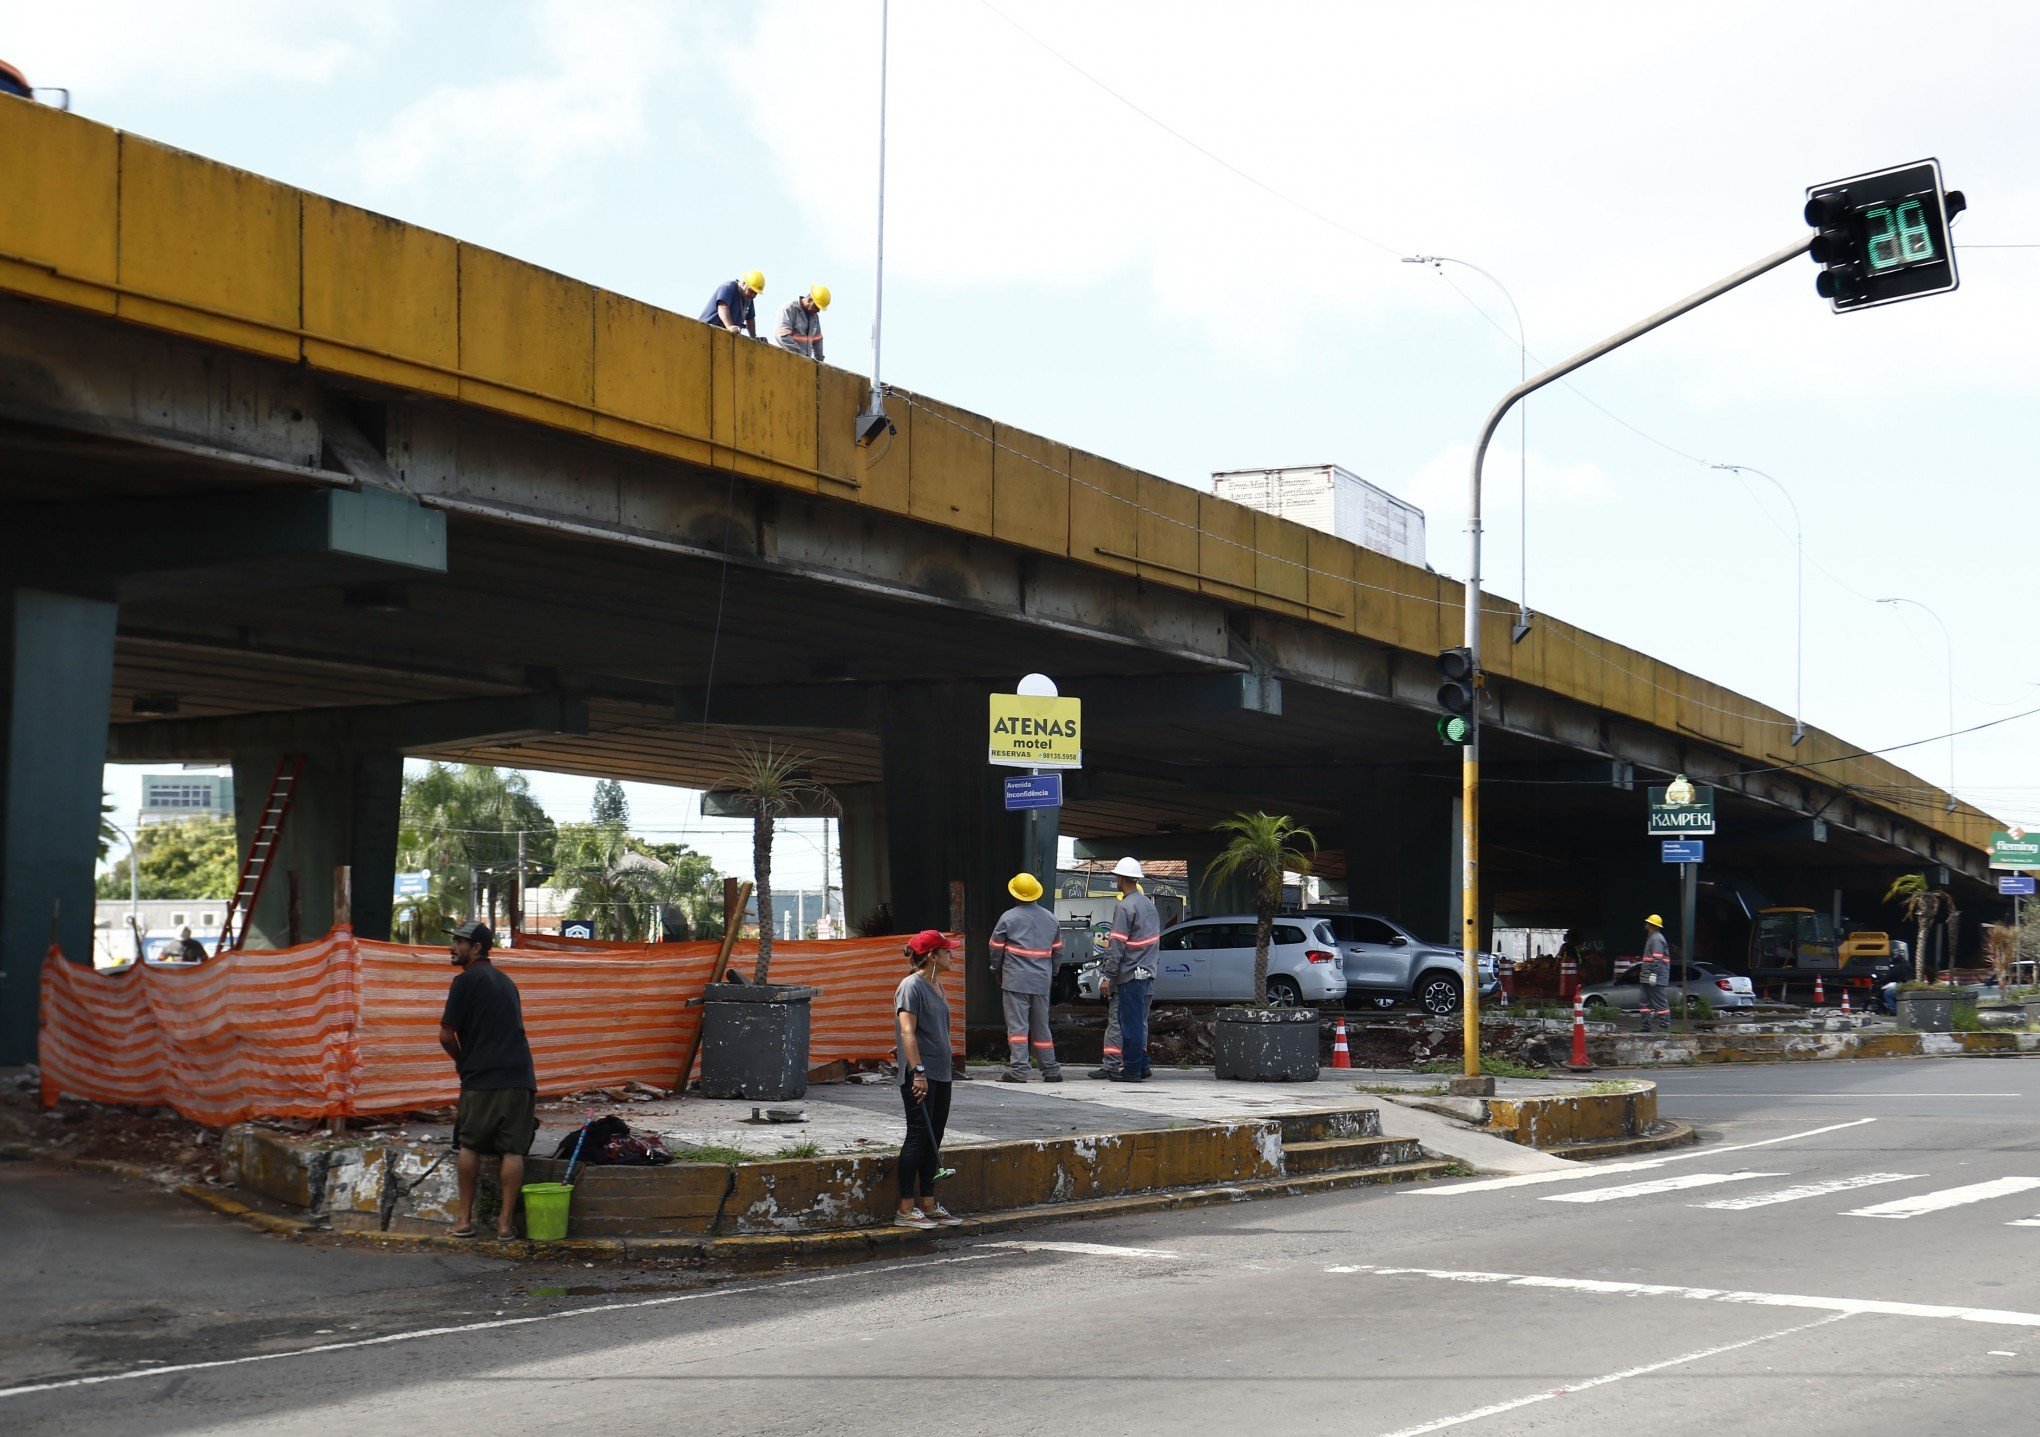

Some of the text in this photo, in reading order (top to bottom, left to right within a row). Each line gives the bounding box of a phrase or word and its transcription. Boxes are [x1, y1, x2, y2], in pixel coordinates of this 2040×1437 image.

[1866, 199, 1934, 270] 28
[993, 716, 1077, 738] ATENAS
[1013, 738, 1052, 750] motel
[991, 749, 1031, 758] RESERVAS
[1006, 781, 1032, 789] Avenida
[1006, 789, 1049, 799] Inconfidência
[1652, 812, 1711, 827] KAMPEKI
[1996, 840, 2039, 853] fleming
